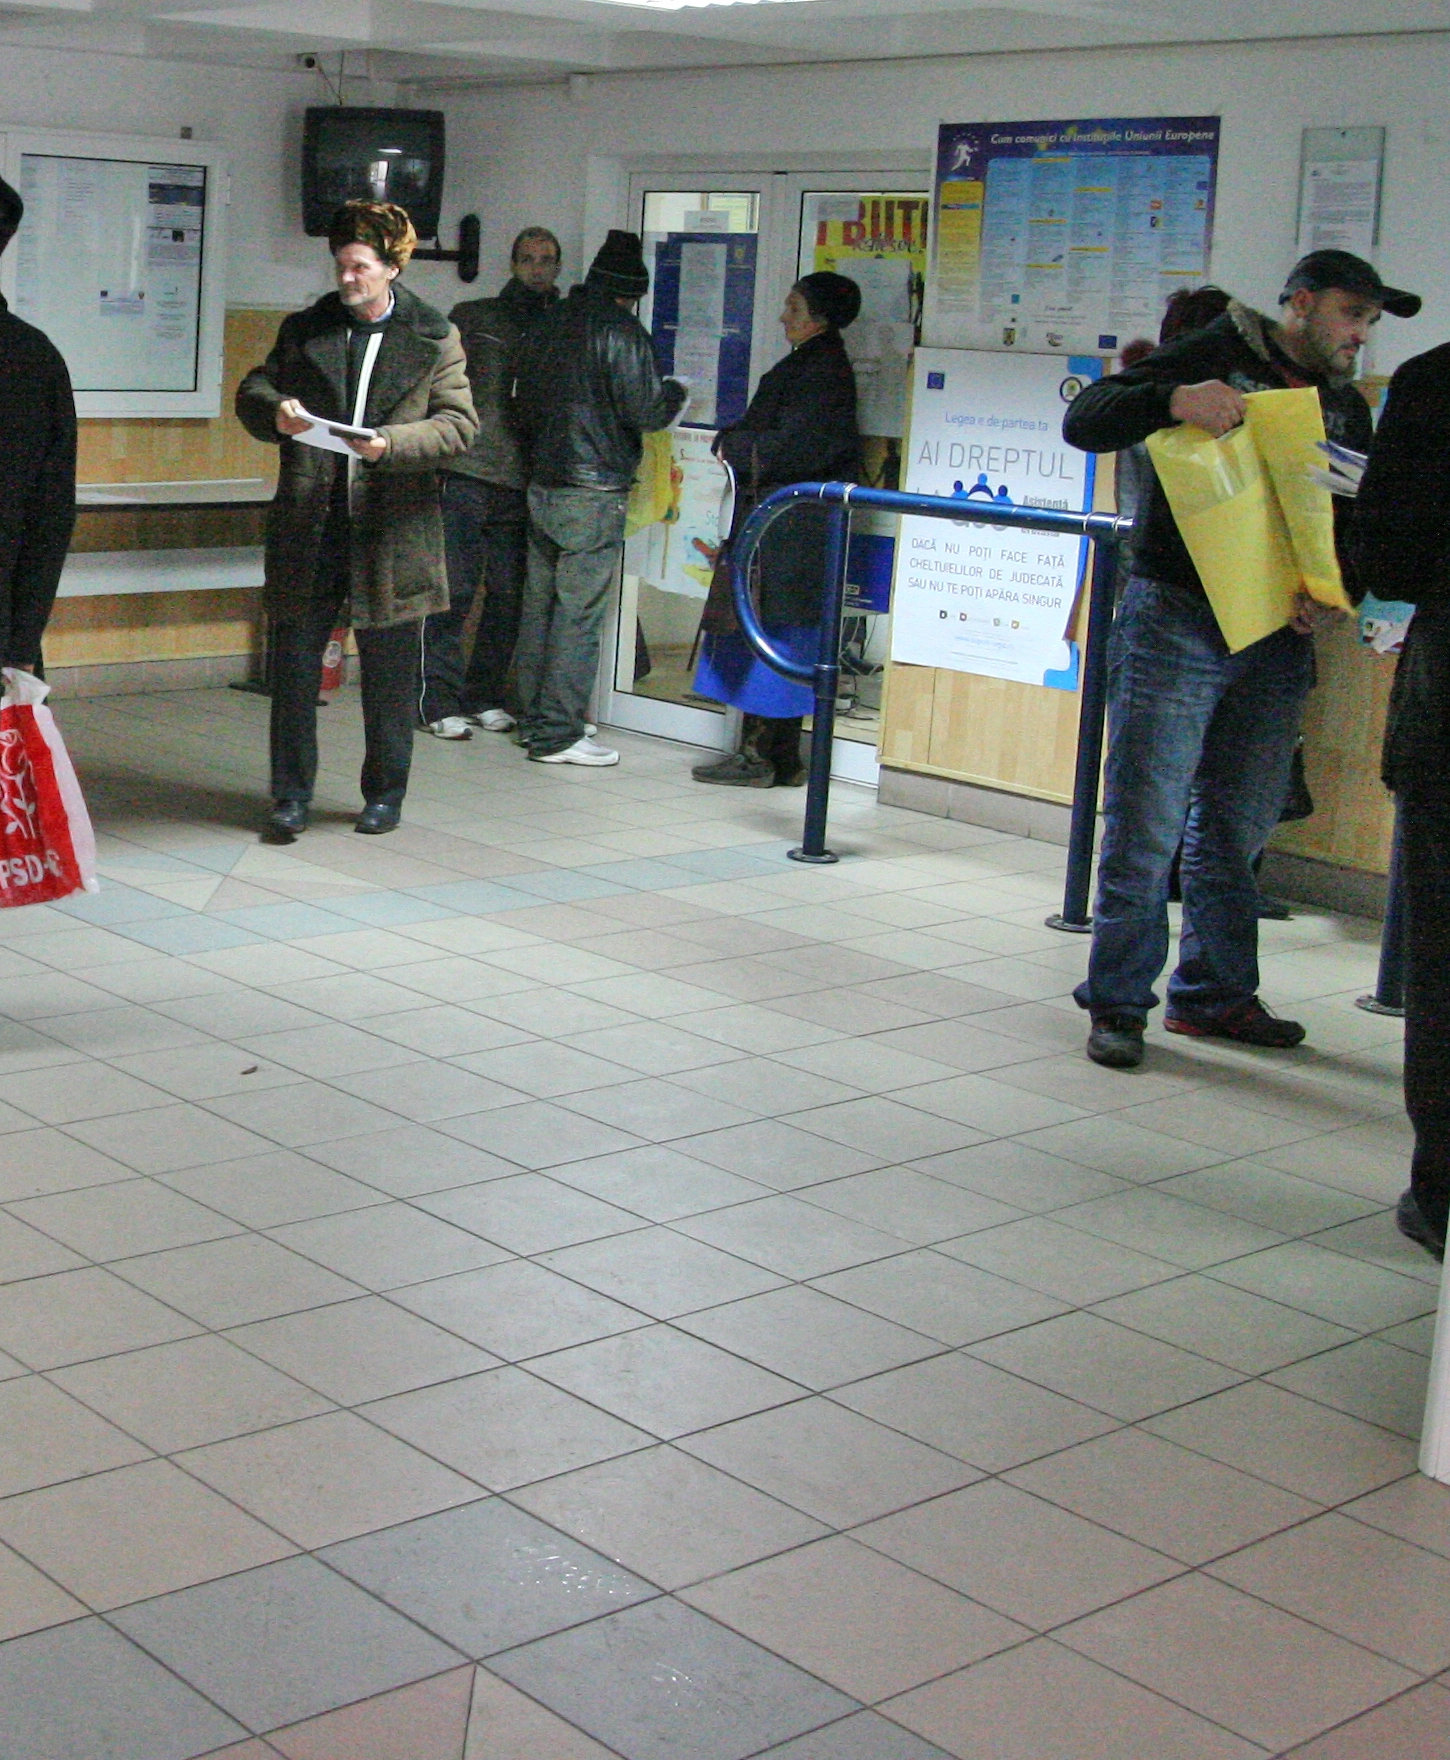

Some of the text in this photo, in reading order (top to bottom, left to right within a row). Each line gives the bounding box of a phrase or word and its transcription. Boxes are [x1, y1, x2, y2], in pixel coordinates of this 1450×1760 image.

[990, 134, 1013, 144] Cum
[1125, 129, 1162, 141] Uniunii
[1165, 129, 1214, 143] Europene
[945, 412, 1048, 431] Legea e de partea ta
[918, 440, 1074, 480] AI DREPTUL
[945, 542, 960, 554] NU
[1001, 549, 1028, 564] FACE
[910, 557, 1064, 588] CHELTUIELILOR DE JUDECATĂ
[908, 577, 927, 590] SAU
[929, 580, 944, 592] NU
[947, 582, 959, 595] TE
[1022, 593, 1062, 609] SINGUR
